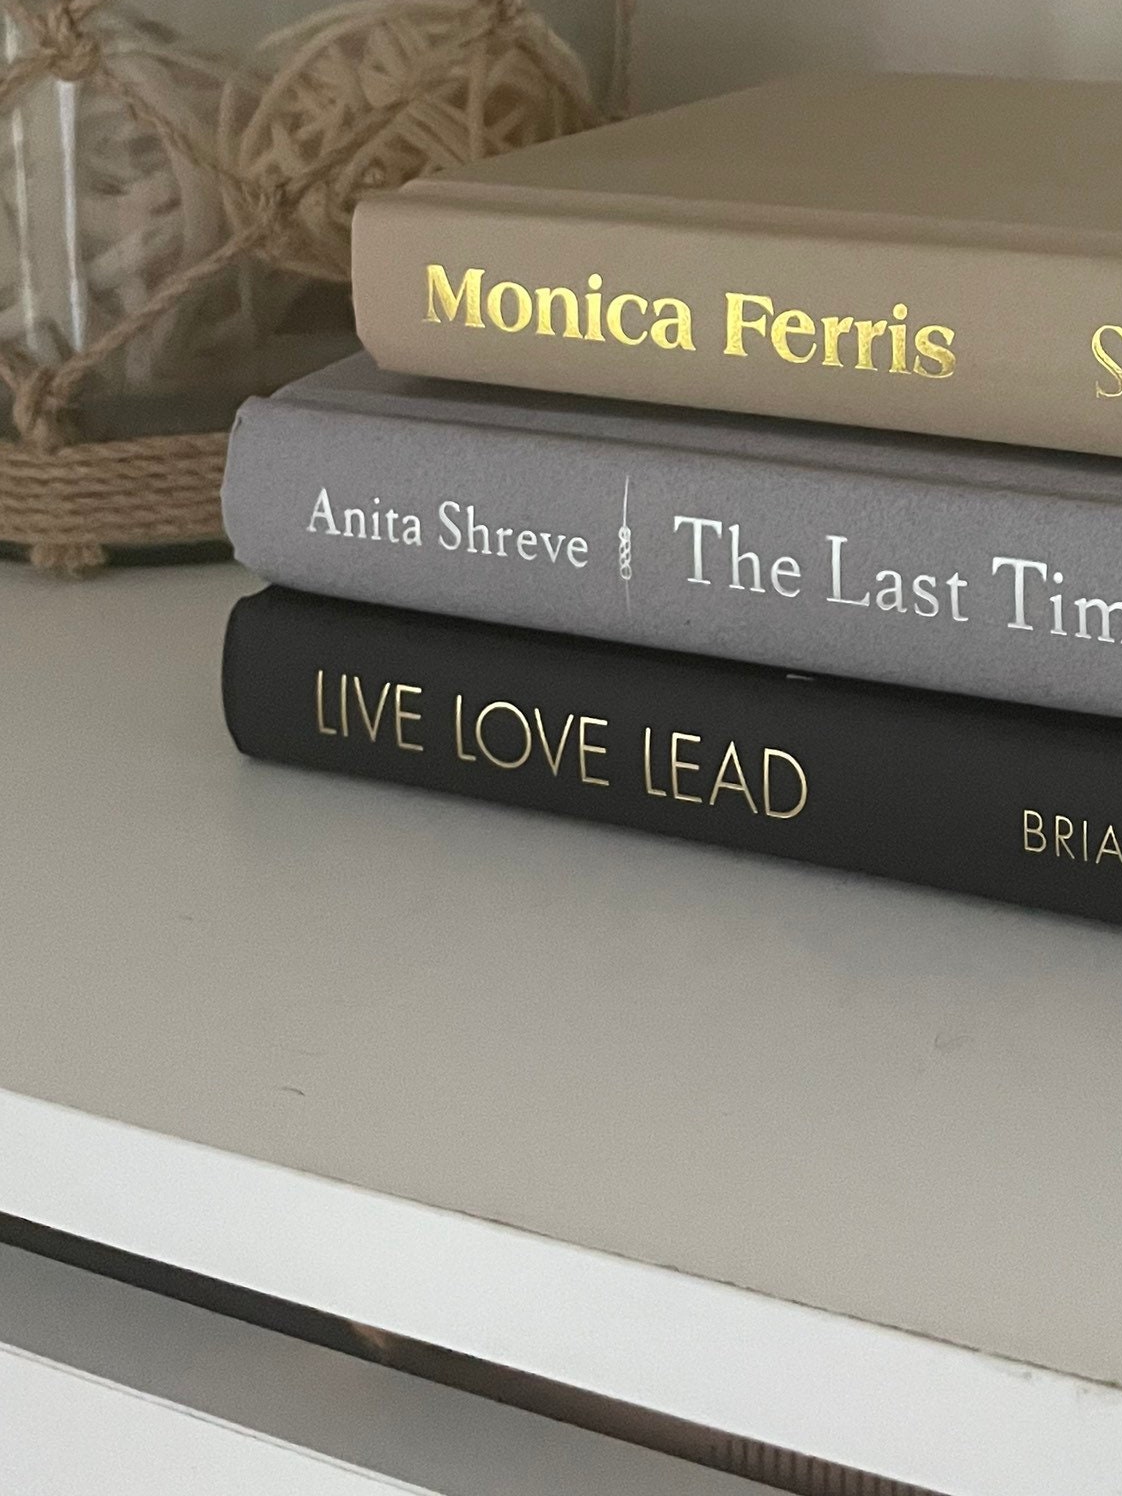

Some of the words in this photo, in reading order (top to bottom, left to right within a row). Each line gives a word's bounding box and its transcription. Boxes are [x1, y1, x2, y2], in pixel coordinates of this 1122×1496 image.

[422, 263, 697, 353] Monica
[723, 291, 957, 379] Ferris
[306, 487, 423, 547] Anita
[437, 500, 590, 569] Shreve
[673, 515, 801, 598] The
[826, 534, 970, 623] Last
[316, 669, 424, 752] LIVE
[454, 694, 610, 786] LOVE
[644, 726, 809, 819] LEAD
